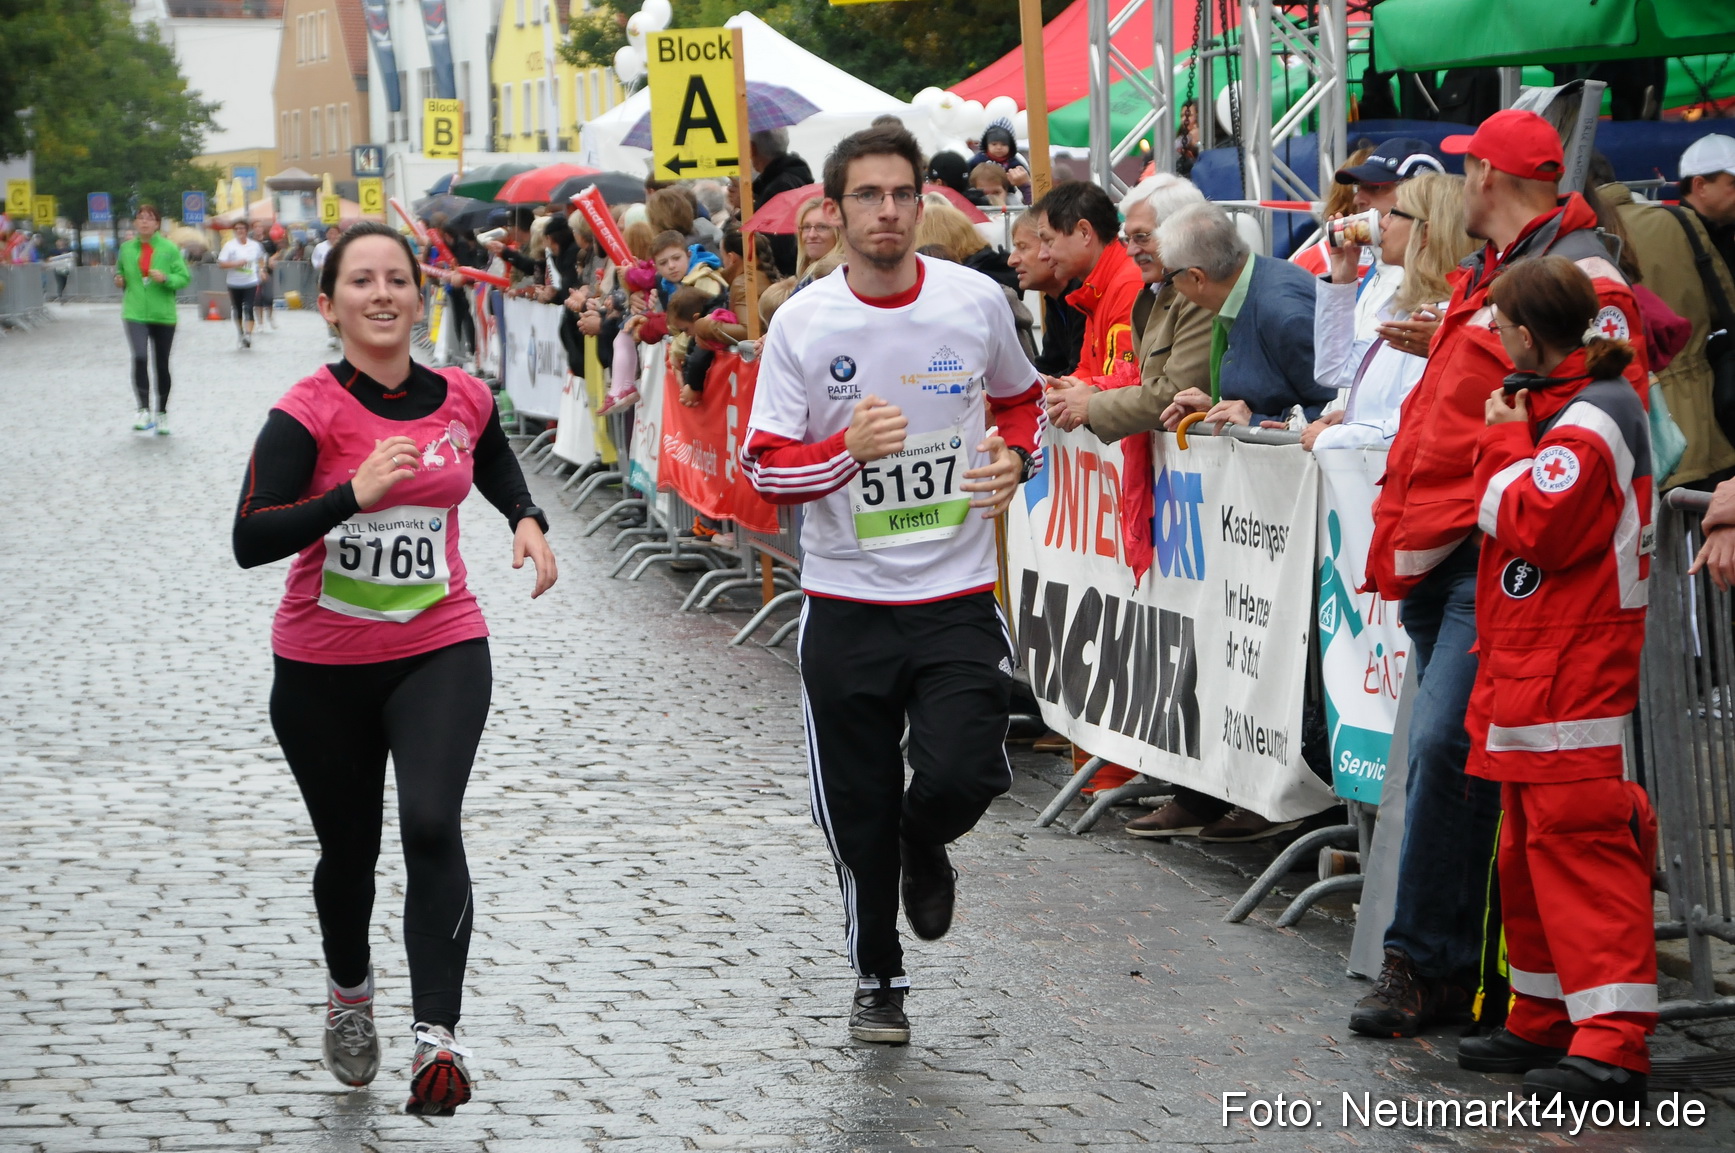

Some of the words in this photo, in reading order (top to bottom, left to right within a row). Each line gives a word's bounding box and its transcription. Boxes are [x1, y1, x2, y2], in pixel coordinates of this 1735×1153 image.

[658, 34, 732, 62] Block
[428, 101, 459, 113] Block
[673, 74, 728, 146] A
[434, 117, 453, 146] B
[12, 188, 24, 206] C
[365, 188, 377, 206] C
[38, 204, 48, 218] D
[91, 212, 107, 220] TAXI
[185, 212, 202, 221] TAXI
[326, 204, 335, 217] D
[581, 200, 605, 227] Audi
[901, 374, 920, 385] 14.
[827, 385, 861, 395] PARTL
[891, 442, 945, 459] Neumarkt
[1540, 449, 1577, 470] DEUTSCHES
[861, 455, 957, 507] 5137
[1536, 466, 1548, 488] ROTES
[1549, 474, 1574, 489] KREUZ
[368, 519, 424, 532] Neumarkt
[888, 510, 940, 532] Kristof
[339, 535, 435, 579] 5169
